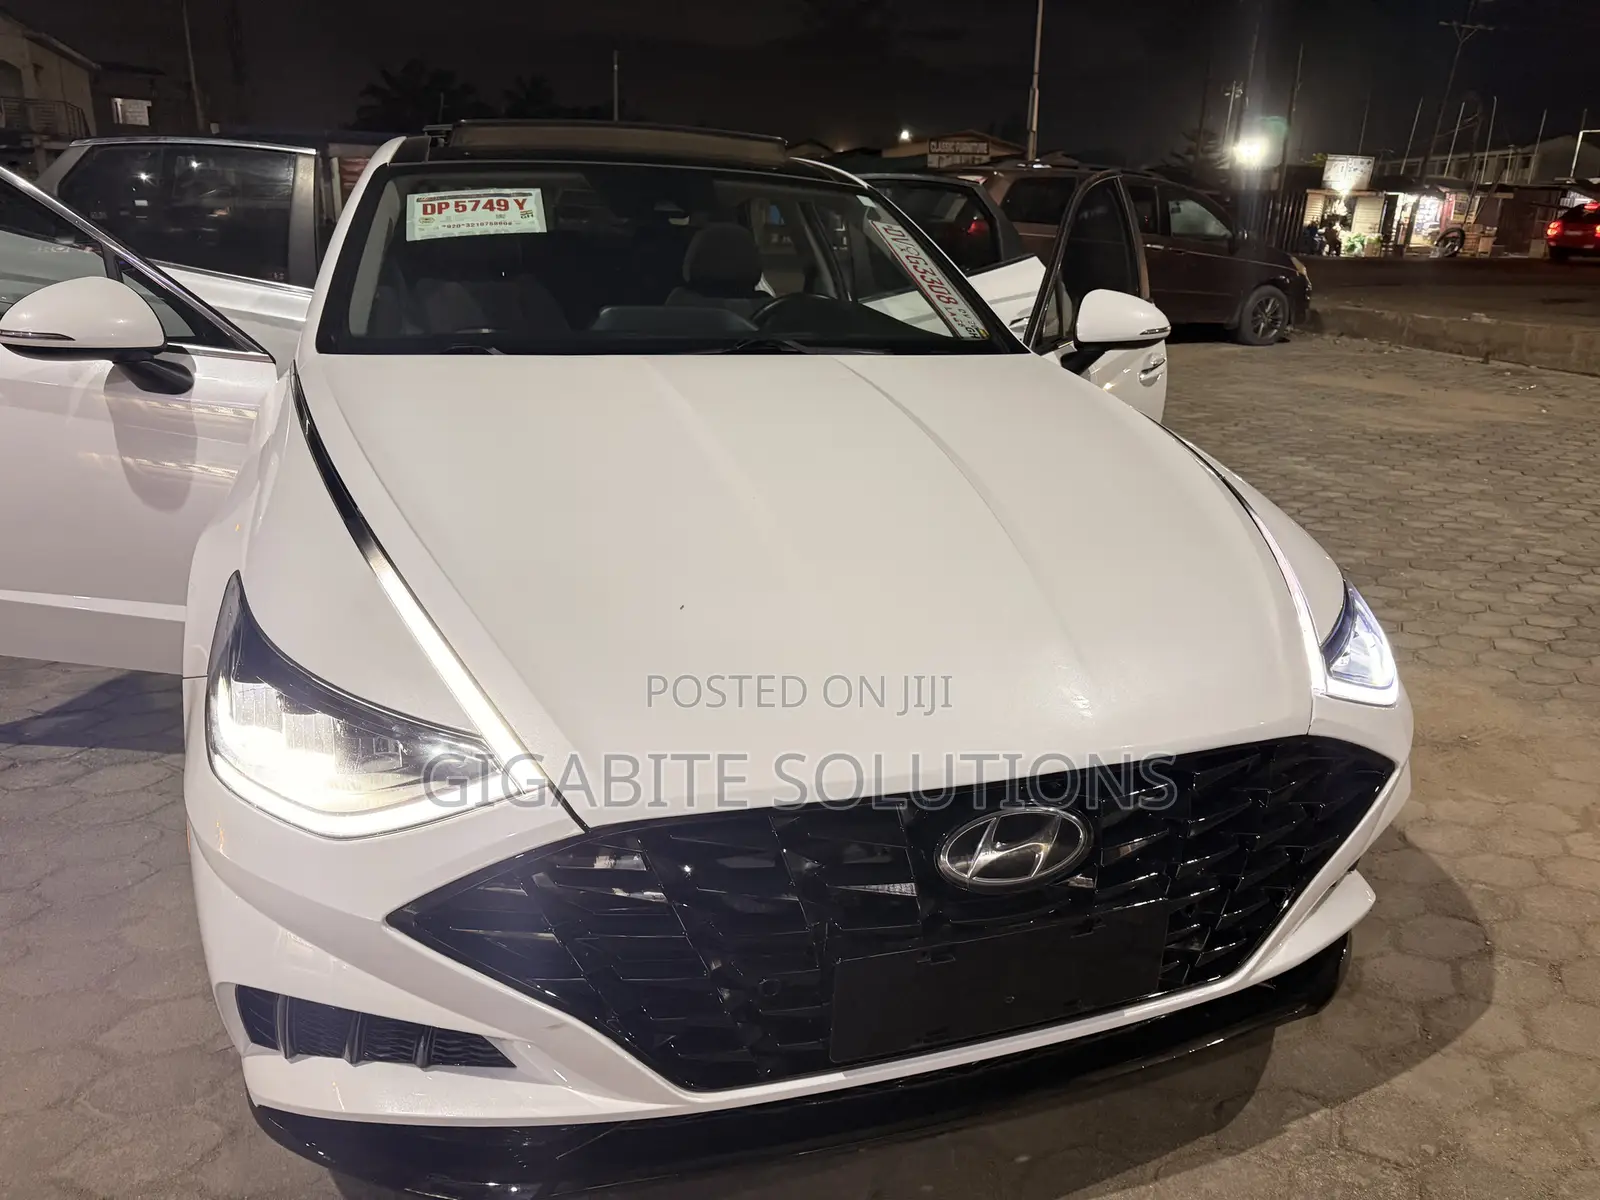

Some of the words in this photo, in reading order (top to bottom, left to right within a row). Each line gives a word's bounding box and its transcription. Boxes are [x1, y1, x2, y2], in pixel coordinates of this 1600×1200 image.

[422, 201, 450, 216] DP
[454, 199, 510, 213] 5749
[513, 198, 528, 211] Y
